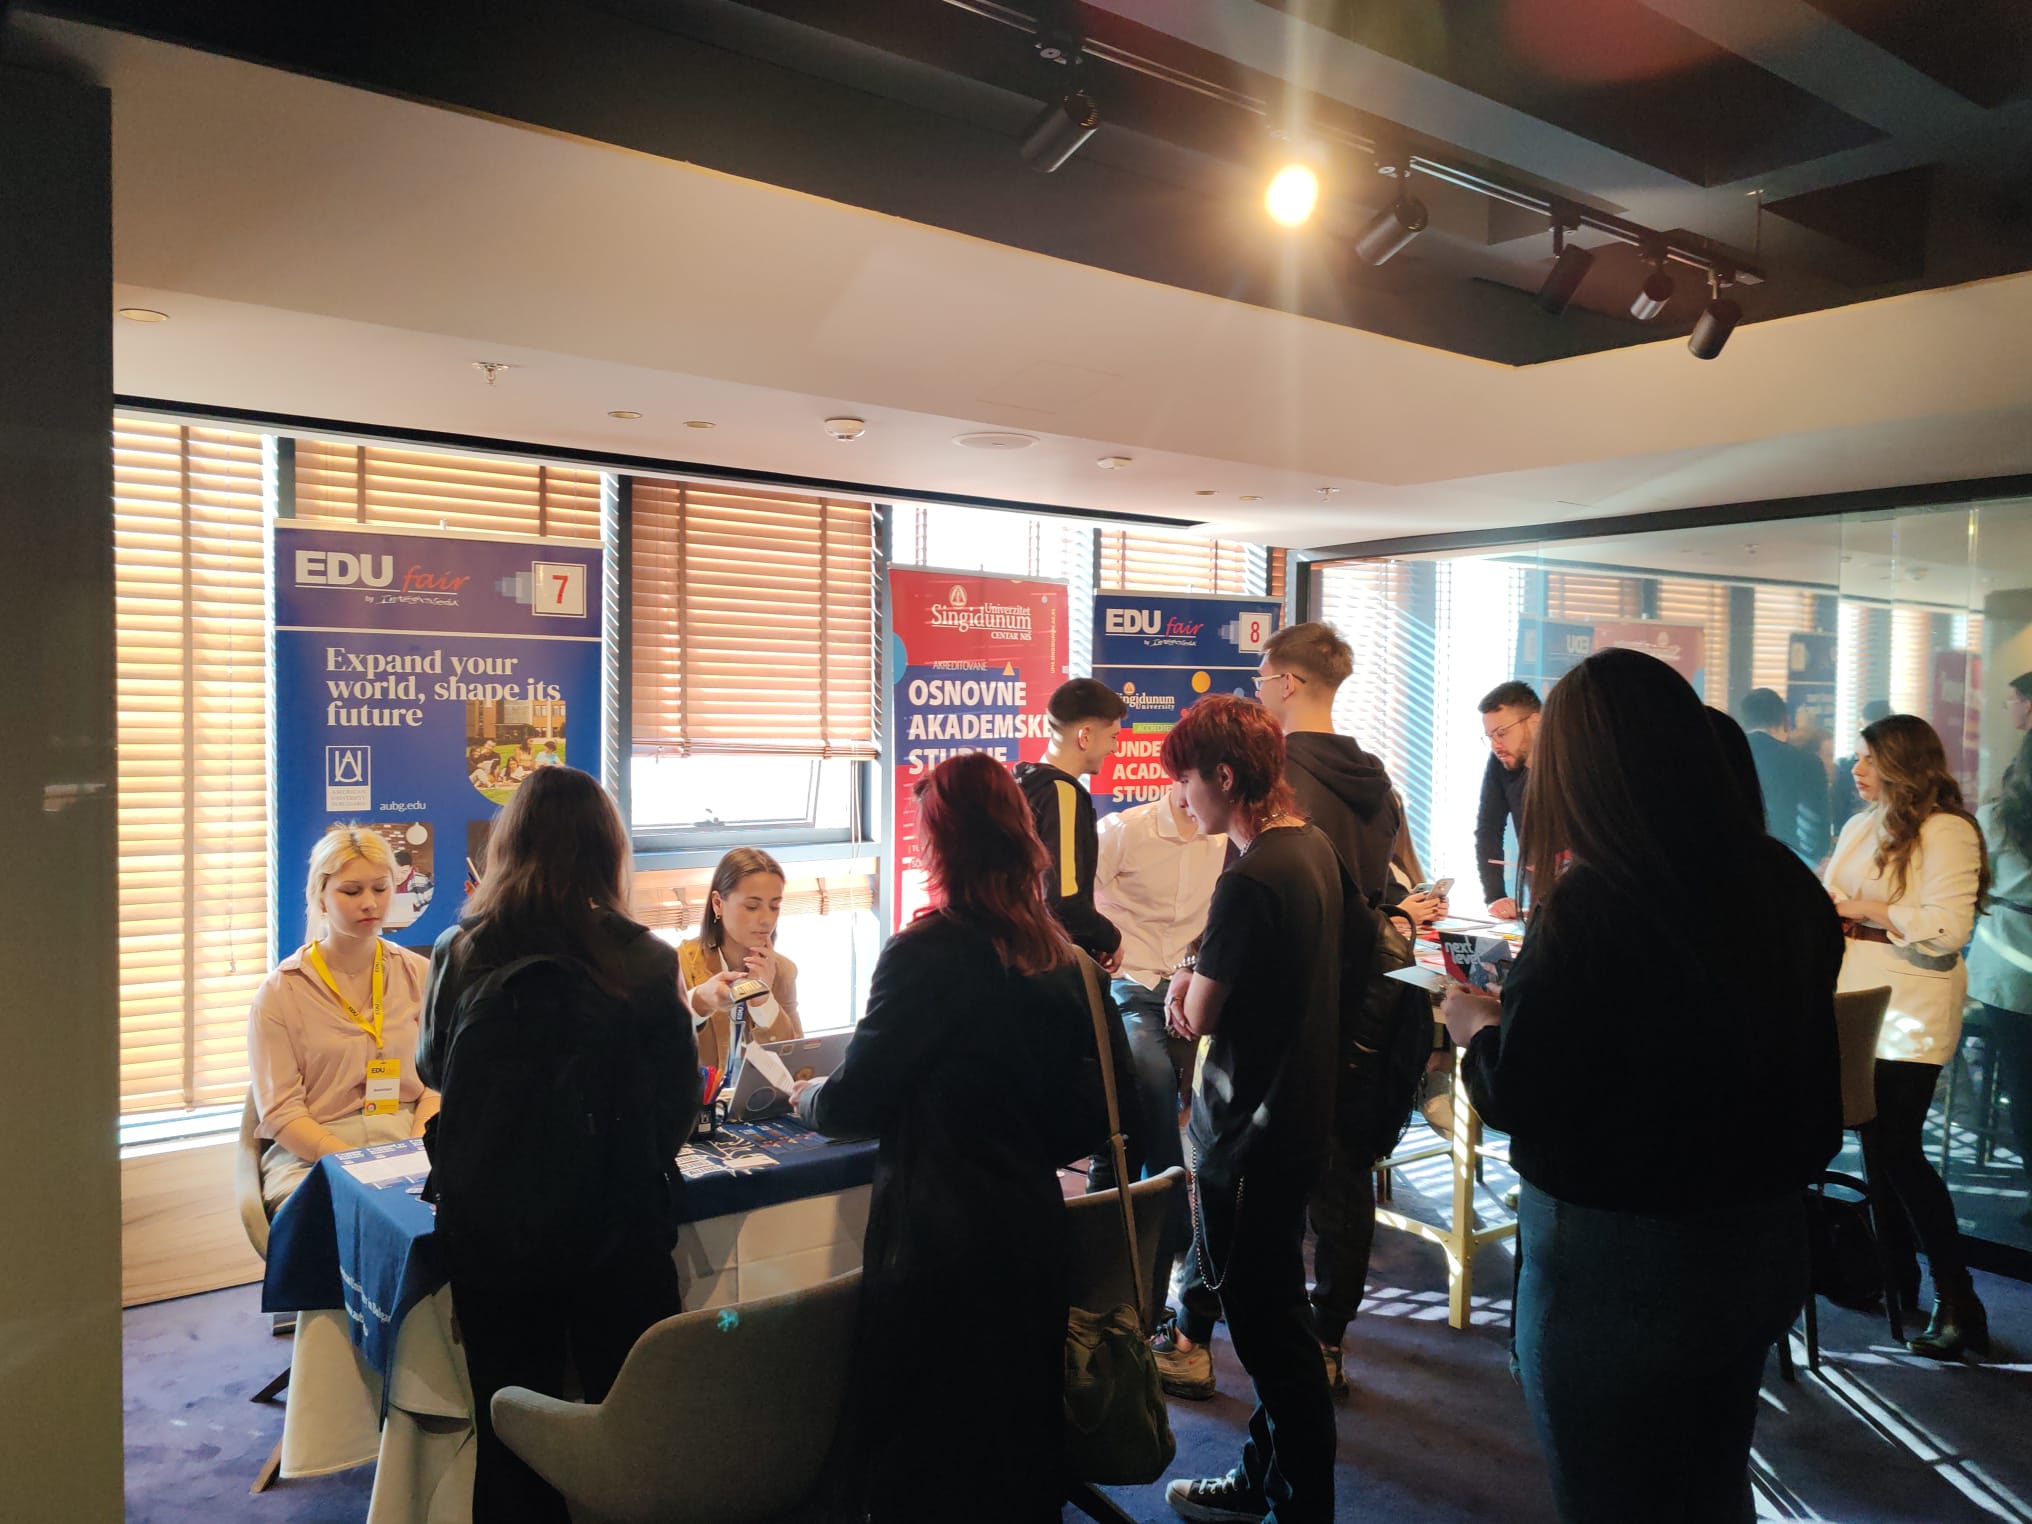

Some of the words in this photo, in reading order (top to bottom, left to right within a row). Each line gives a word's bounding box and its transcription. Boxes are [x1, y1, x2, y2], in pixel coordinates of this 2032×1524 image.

[295, 550, 393, 587] EDU
[402, 565, 471, 592] fair
[552, 575, 569, 604] 7
[931, 603, 1032, 633] Singidunum
[984, 602, 1031, 616] Univerzitet
[991, 631, 1019, 640] CENTAR
[1105, 608, 1162, 634] EDU
[1165, 616, 1205, 637] fair
[1250, 621, 1260, 643] 8
[325, 647, 442, 681] Expand
[449, 656, 519, 681] your
[932, 660, 988, 671] AKREDITOVANE
[326, 676, 426, 704] world,
[433, 676, 520, 706] shape
[526, 678, 562, 702] its
[908, 679, 1027, 706] OSNOVNE
[326, 701, 424, 727] future
[1135, 703, 1175, 712] University
[379, 800, 427, 812] aubg.edu
